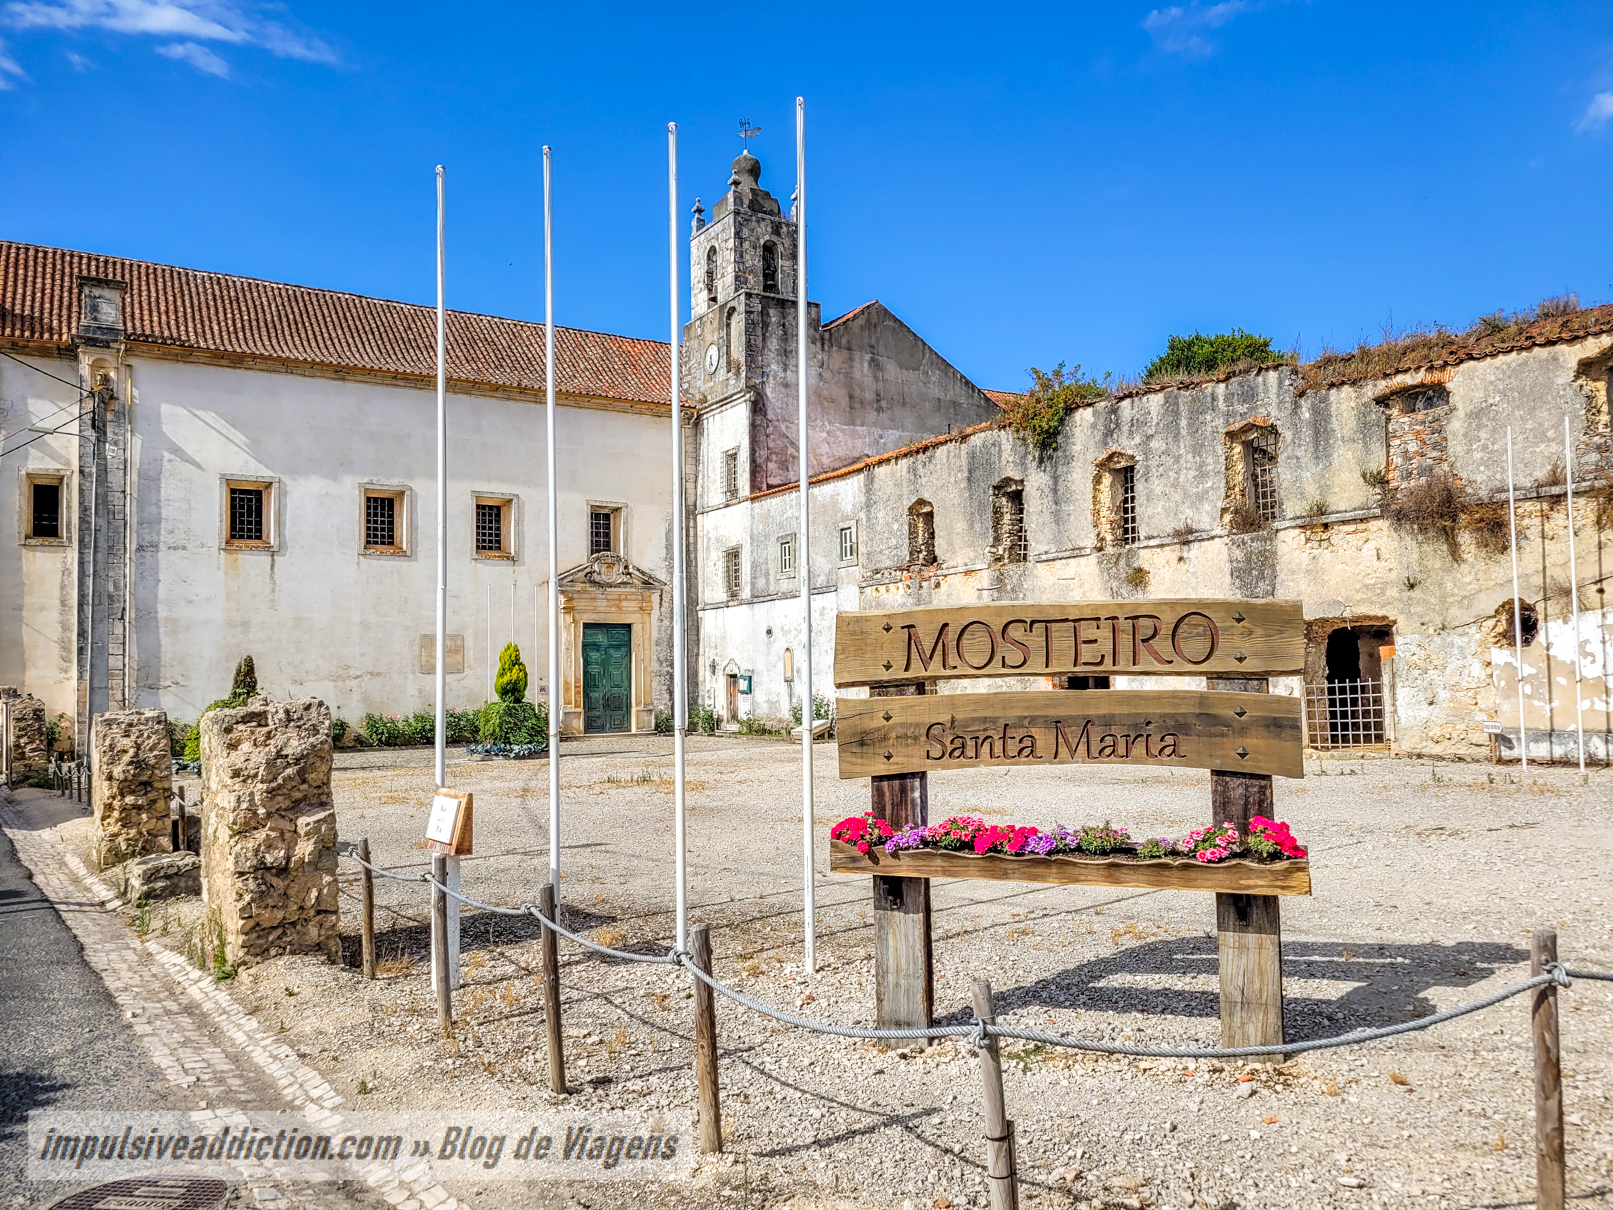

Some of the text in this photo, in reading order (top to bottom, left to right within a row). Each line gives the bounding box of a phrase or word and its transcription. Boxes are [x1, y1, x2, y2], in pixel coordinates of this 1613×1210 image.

[901, 611, 1220, 672] MOSTEIRO
[925, 719, 1187, 761] Santa Maria
